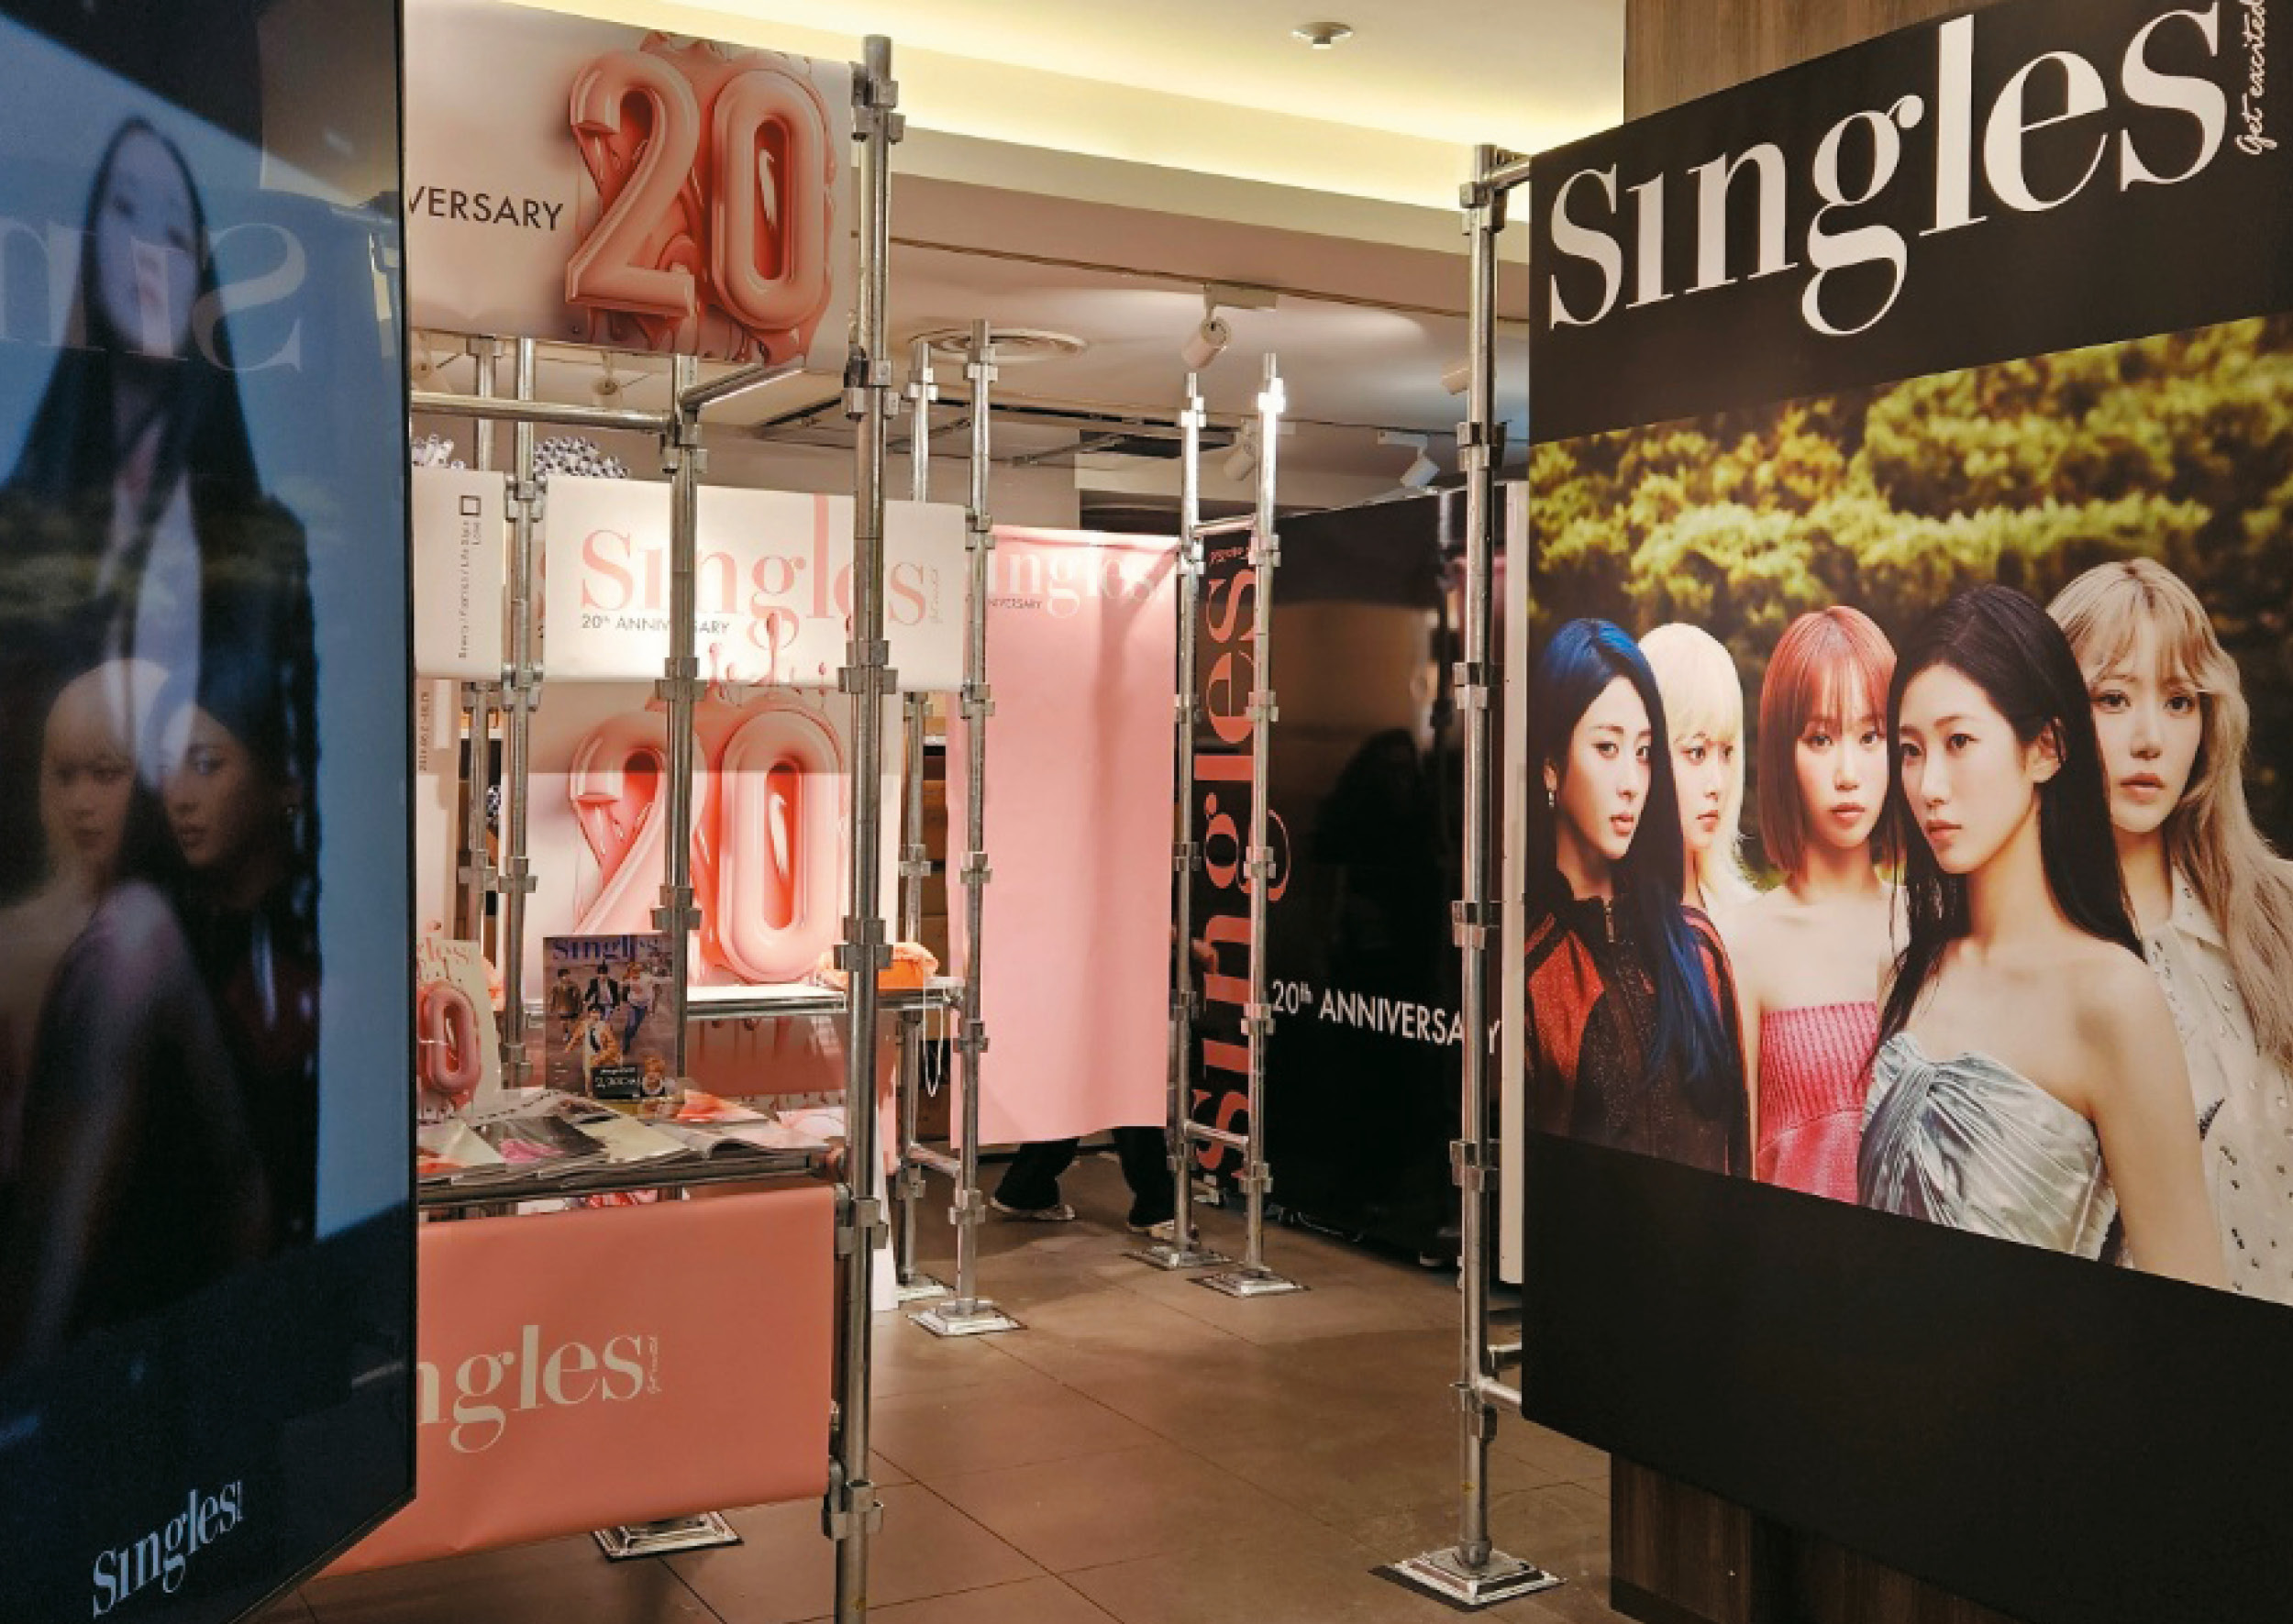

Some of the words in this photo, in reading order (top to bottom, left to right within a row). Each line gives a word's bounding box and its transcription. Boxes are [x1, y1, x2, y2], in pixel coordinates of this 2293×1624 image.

[566, 48, 831, 332] 20
[1550, 4, 2228, 336] Singles
[2234, 94, 2278, 155] Get
[1272, 979, 1313, 1015] 20th
[1318, 989, 1502, 1055] ANNIVERSAY
[94, 1483, 237, 1620] Singles
